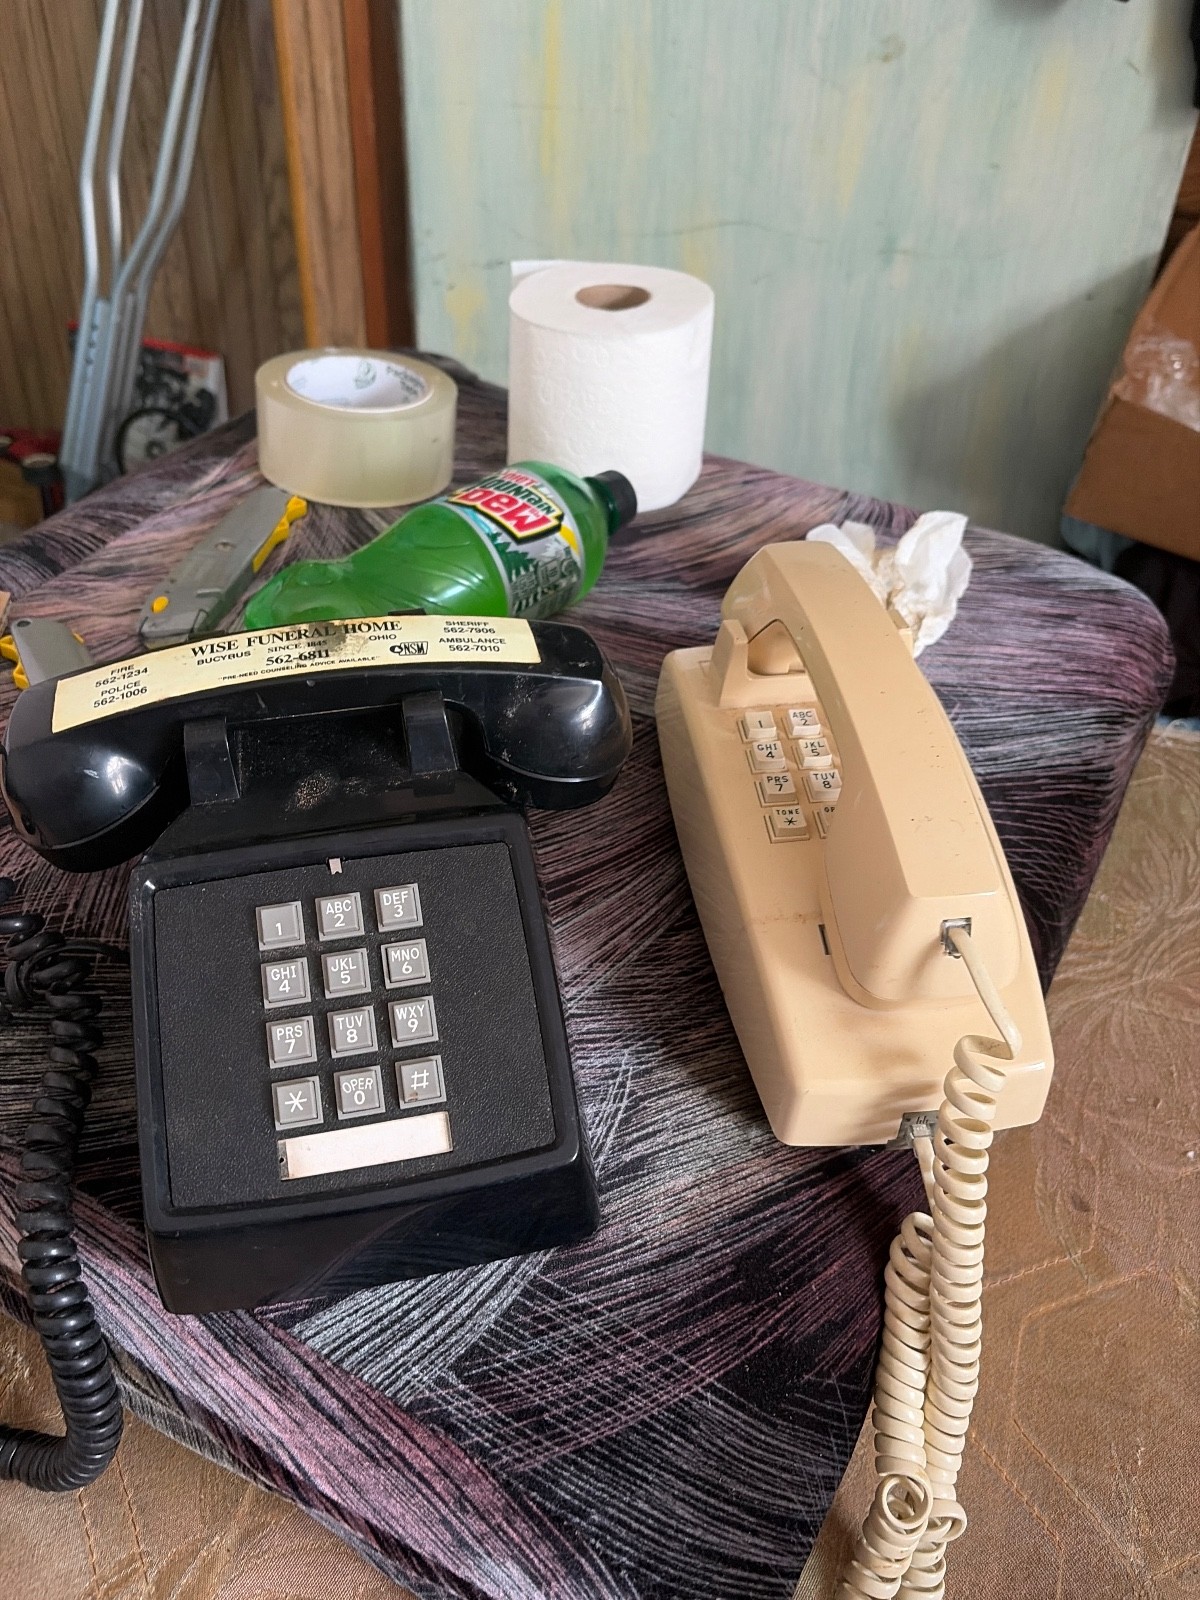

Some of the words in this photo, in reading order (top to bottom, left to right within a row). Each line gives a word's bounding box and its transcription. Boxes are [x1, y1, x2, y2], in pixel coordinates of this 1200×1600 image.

[443, 626, 496, 635] 562-7906
[191, 639, 238, 658] WISE
[246, 625, 336, 648] FUNERAL
[343, 620, 402, 635] HOME
[438, 636, 507, 645] AMBULANCE
[197, 650, 251, 666] BUCYRUS
[368, 633, 398, 642] OHIO
[267, 643, 302, 654] SINCE
[448, 644, 501, 653] 562-7010
[265, 649, 331, 666] 562-6811
[309, 659, 337, 668] ADVICE
[110, 663, 135, 676] FIRE
[94, 667, 148, 688] 562-1234
[100, 680, 141, 697] POLICE
[93, 686, 148, 709] 562-1006
[792, 710, 814, 719] ABC
[800, 718, 811, 727] 2
[757, 743, 778, 751] GHI
[803, 741, 825, 749] JKL
[811, 748, 820, 757] 5
[765, 750, 775, 759] 4
[766, 775, 789, 783] PRS
[813, 771, 836, 780] TUV
[774, 783, 784, 792] 7
[822, 780, 832, 789] 8
[775, 808, 800, 816] TONE
[382, 890, 410, 906] DEF
[325, 899, 352, 915] ABC
[393, 904, 404, 918] 3
[334, 913, 346, 928] 2
[275, 922, 284, 936] 1
[390, 947, 420, 962] MNO
[270, 964, 298, 981] GHI
[330, 957, 358, 973] JKL
[401, 960, 413, 975] 6
[340, 970, 351, 985] 5
[278, 979, 291, 994] 4
[395, 1003, 425, 1021] WXY
[336, 1014, 363, 1031] TUV
[406, 1018, 419, 1034] 9
[276, 1024, 303, 1041] PRS
[346, 1028, 358, 1044] 8
[284, 1039, 296, 1054] 7
[342, 1077, 374, 1095] OPER
